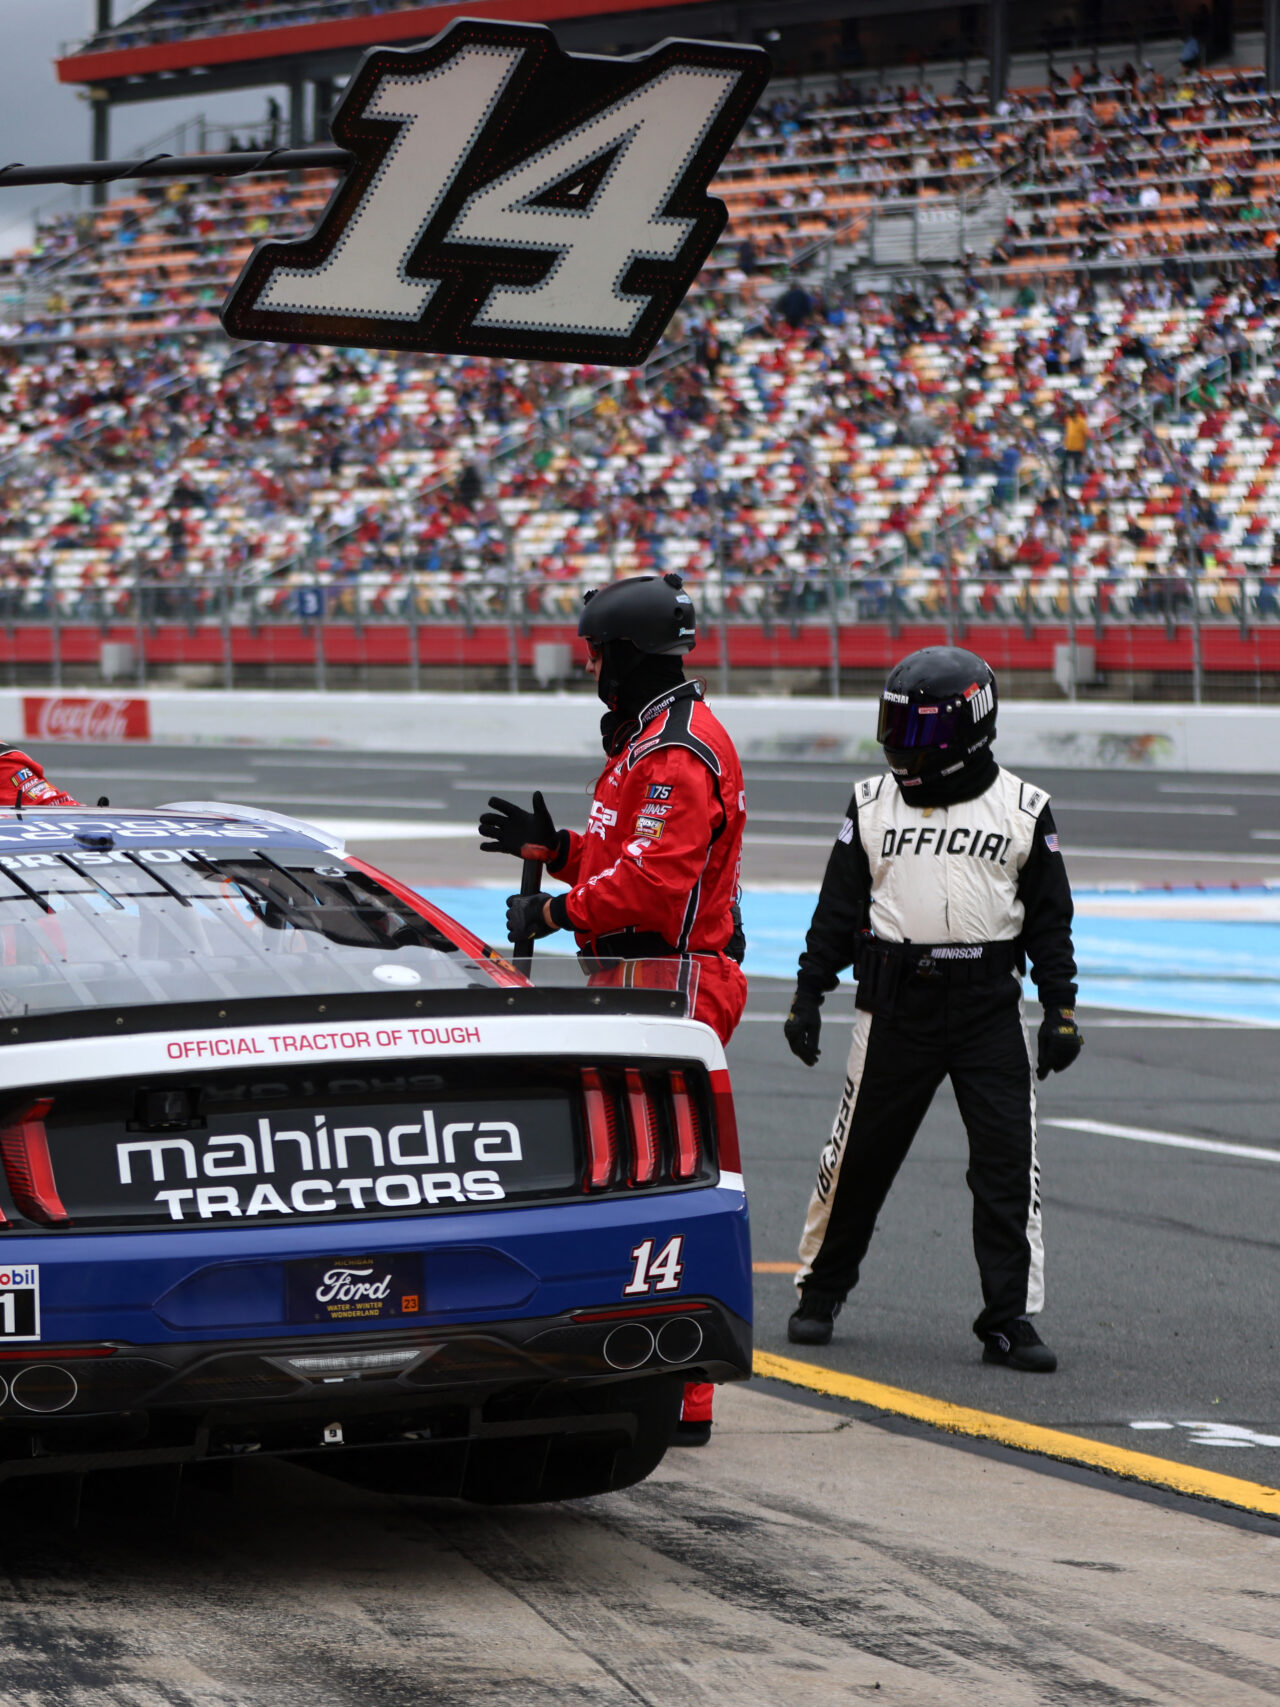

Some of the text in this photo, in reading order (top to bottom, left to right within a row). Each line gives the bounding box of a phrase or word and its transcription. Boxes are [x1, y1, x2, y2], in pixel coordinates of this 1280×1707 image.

[252, 43, 744, 337] 14
[652, 785, 672, 799] 75
[881, 827, 1012, 866] OFFICIAL
[945, 946, 983, 960] NASCAR
[166, 1026, 482, 1060] OFFICIAL TRACTOR OF TOUGH
[115, 1109, 523, 1185] mahindra
[153, 1169, 507, 1221] TRACTORS
[622, 1234, 684, 1296] 14
[315, 1268, 392, 1302] Ford
[326, 1303, 350, 1312] WATER
[355, 1301, 383, 1310] WINTER
[330, 1309, 380, 1319] WONDERLAND
[403, 1298, 418, 1310] 23
